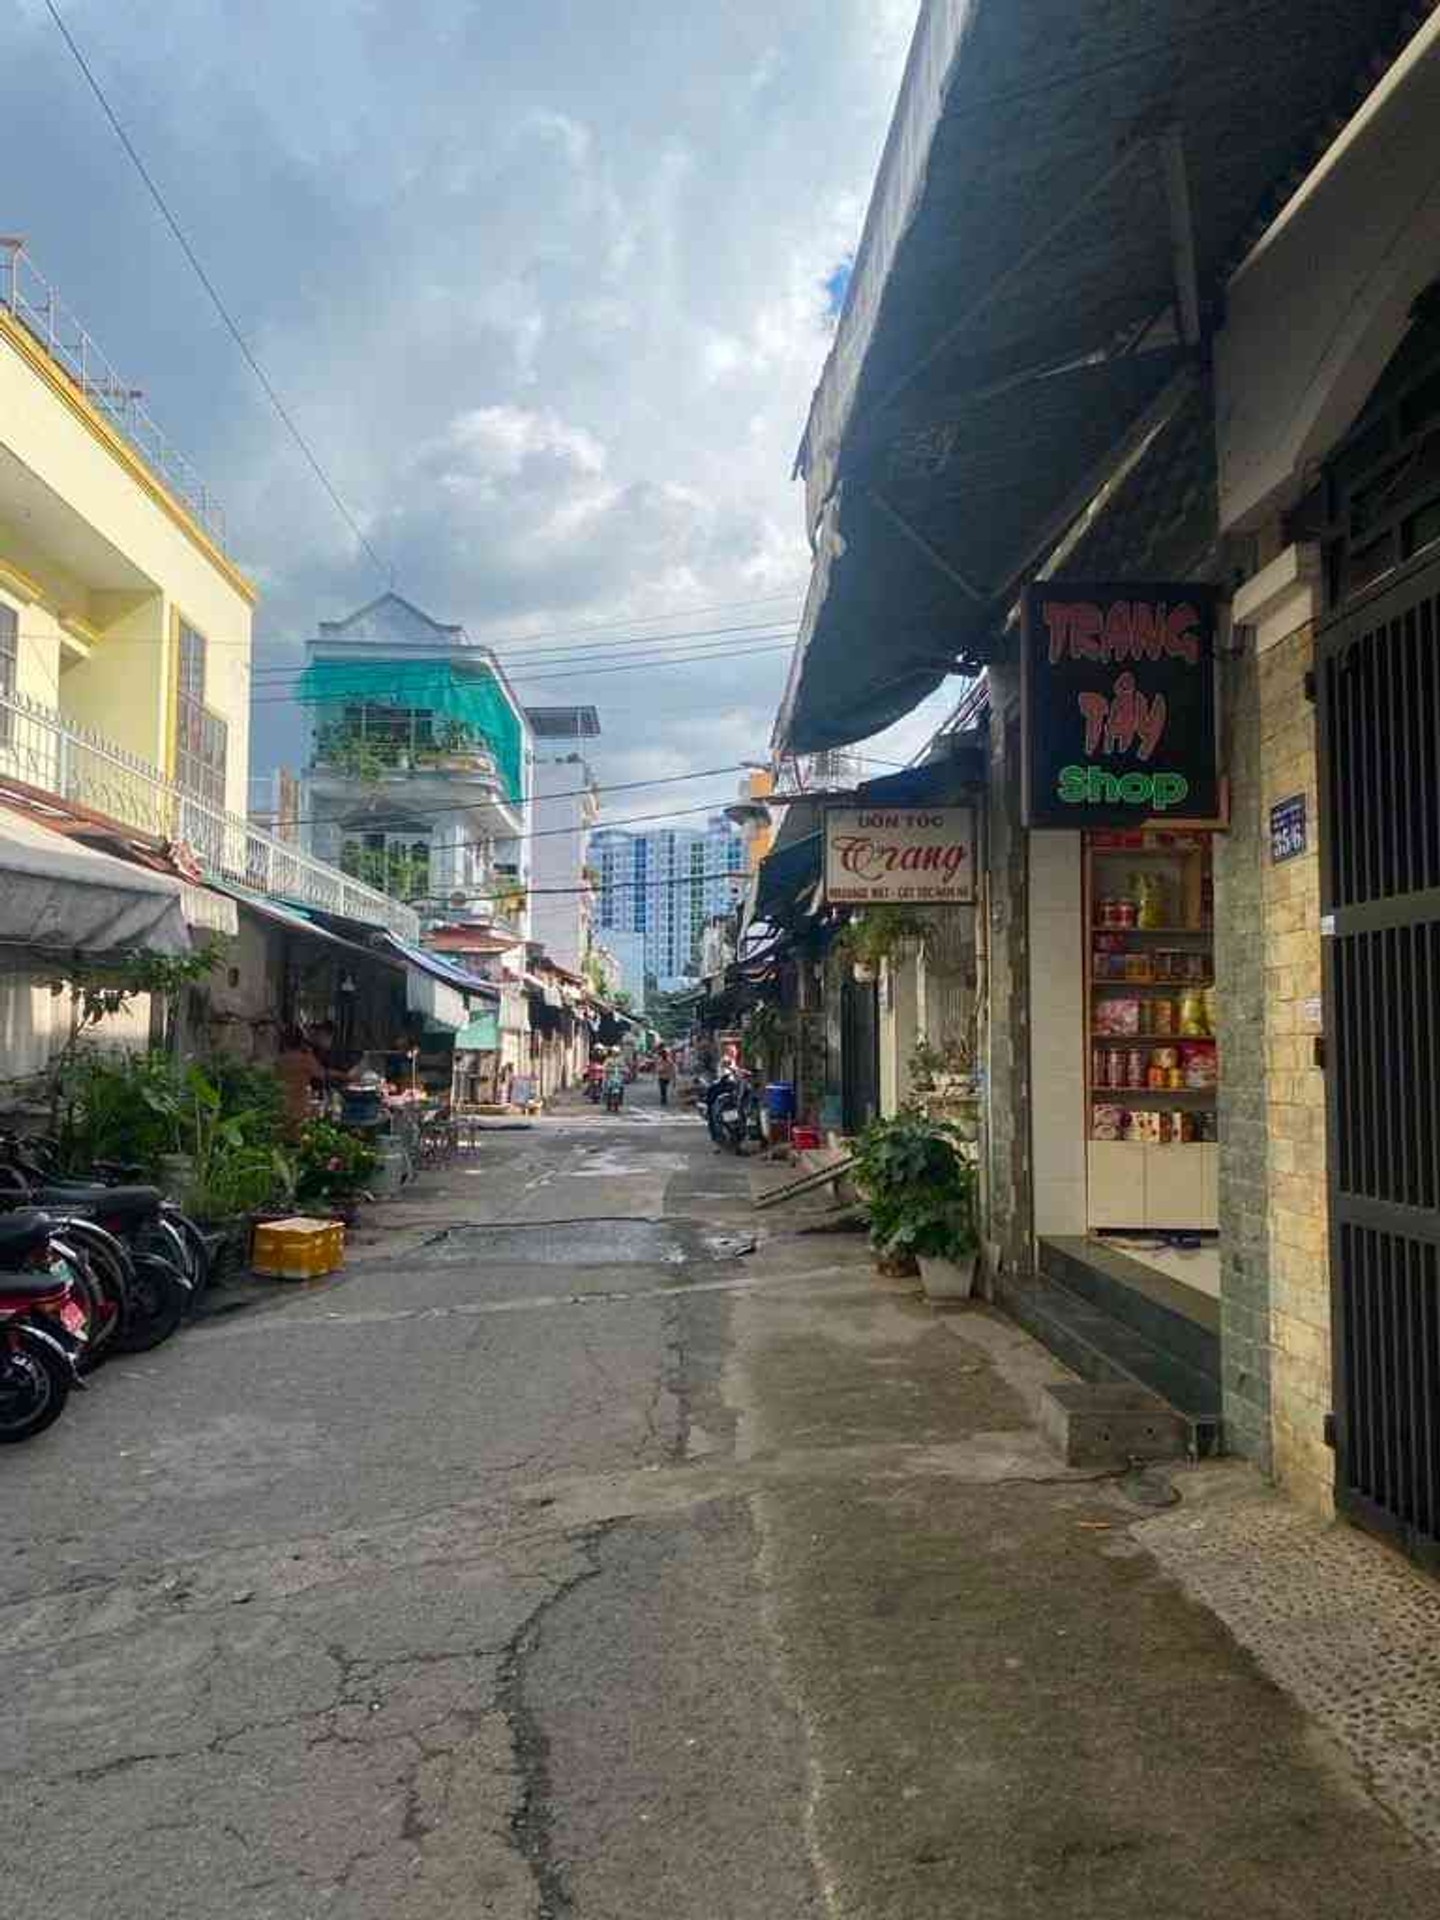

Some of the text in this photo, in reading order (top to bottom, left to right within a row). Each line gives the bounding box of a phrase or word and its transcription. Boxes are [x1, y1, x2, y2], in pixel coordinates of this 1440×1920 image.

[1044, 600, 1200, 664] TRANG
[1057, 765, 1189, 811] Shop
[833, 836, 964, 884] Trang
